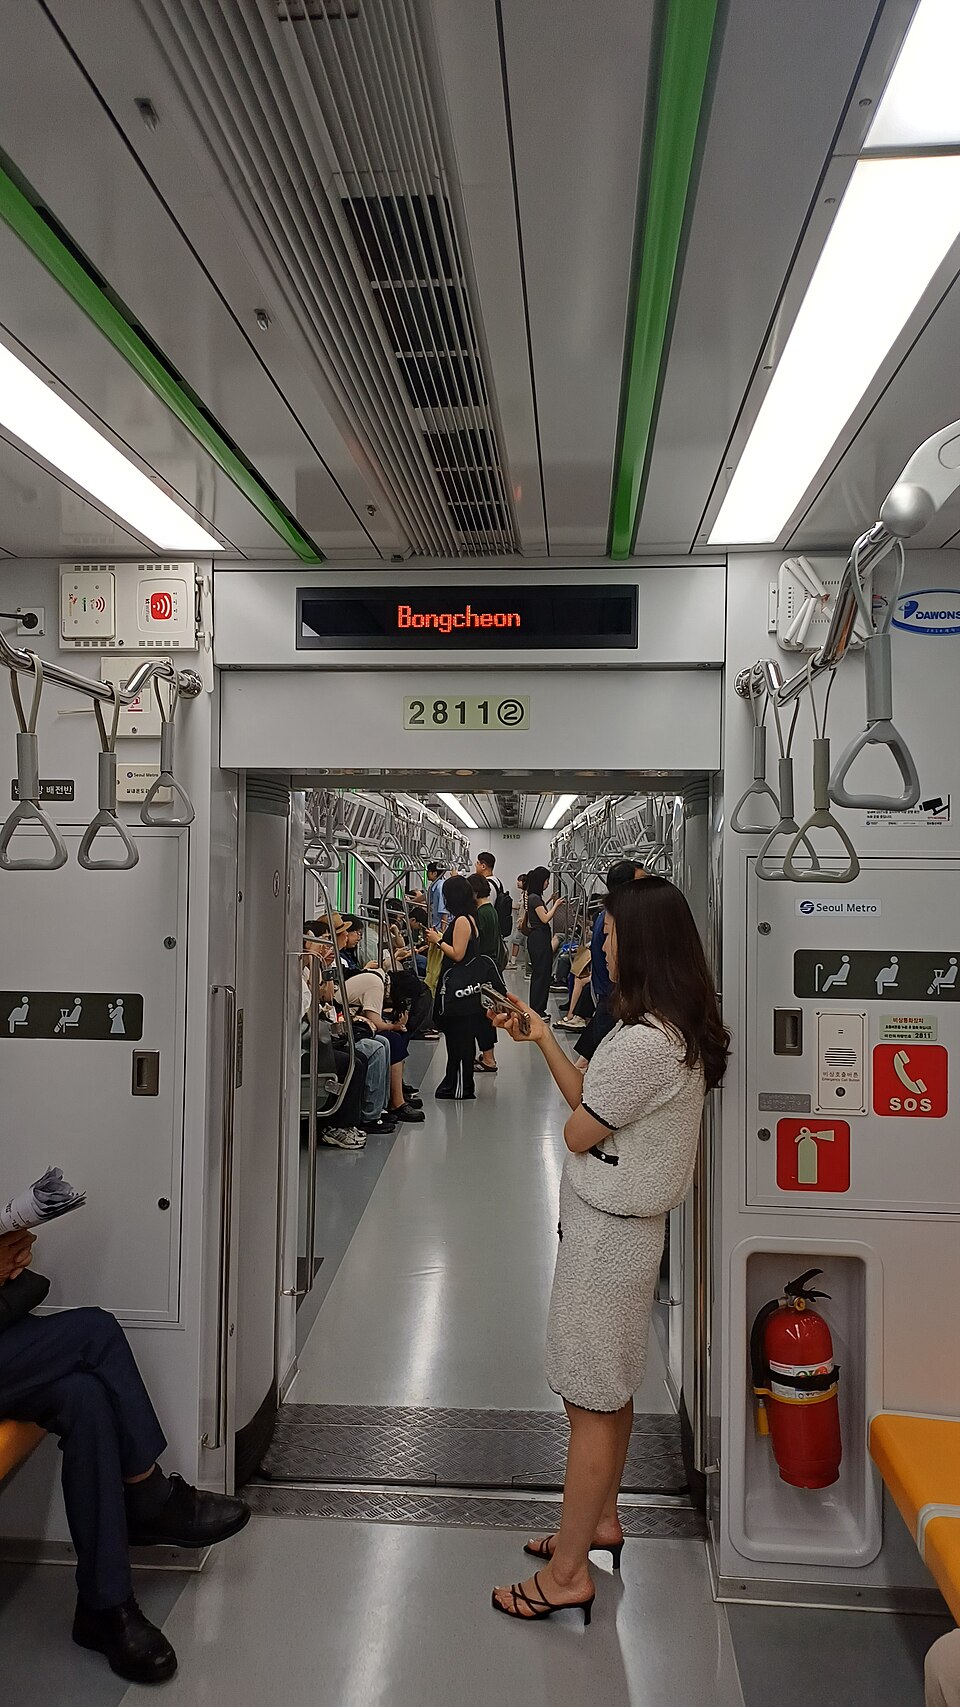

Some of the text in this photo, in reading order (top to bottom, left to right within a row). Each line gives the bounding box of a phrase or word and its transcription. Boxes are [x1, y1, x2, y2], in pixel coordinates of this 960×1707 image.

[398, 605, 521, 633] Bongcheon
[45, 785, 73, 795] 배전반
[816, 902, 878, 913] Seoul Metro
[889, 1097, 932, 1112] SOS
